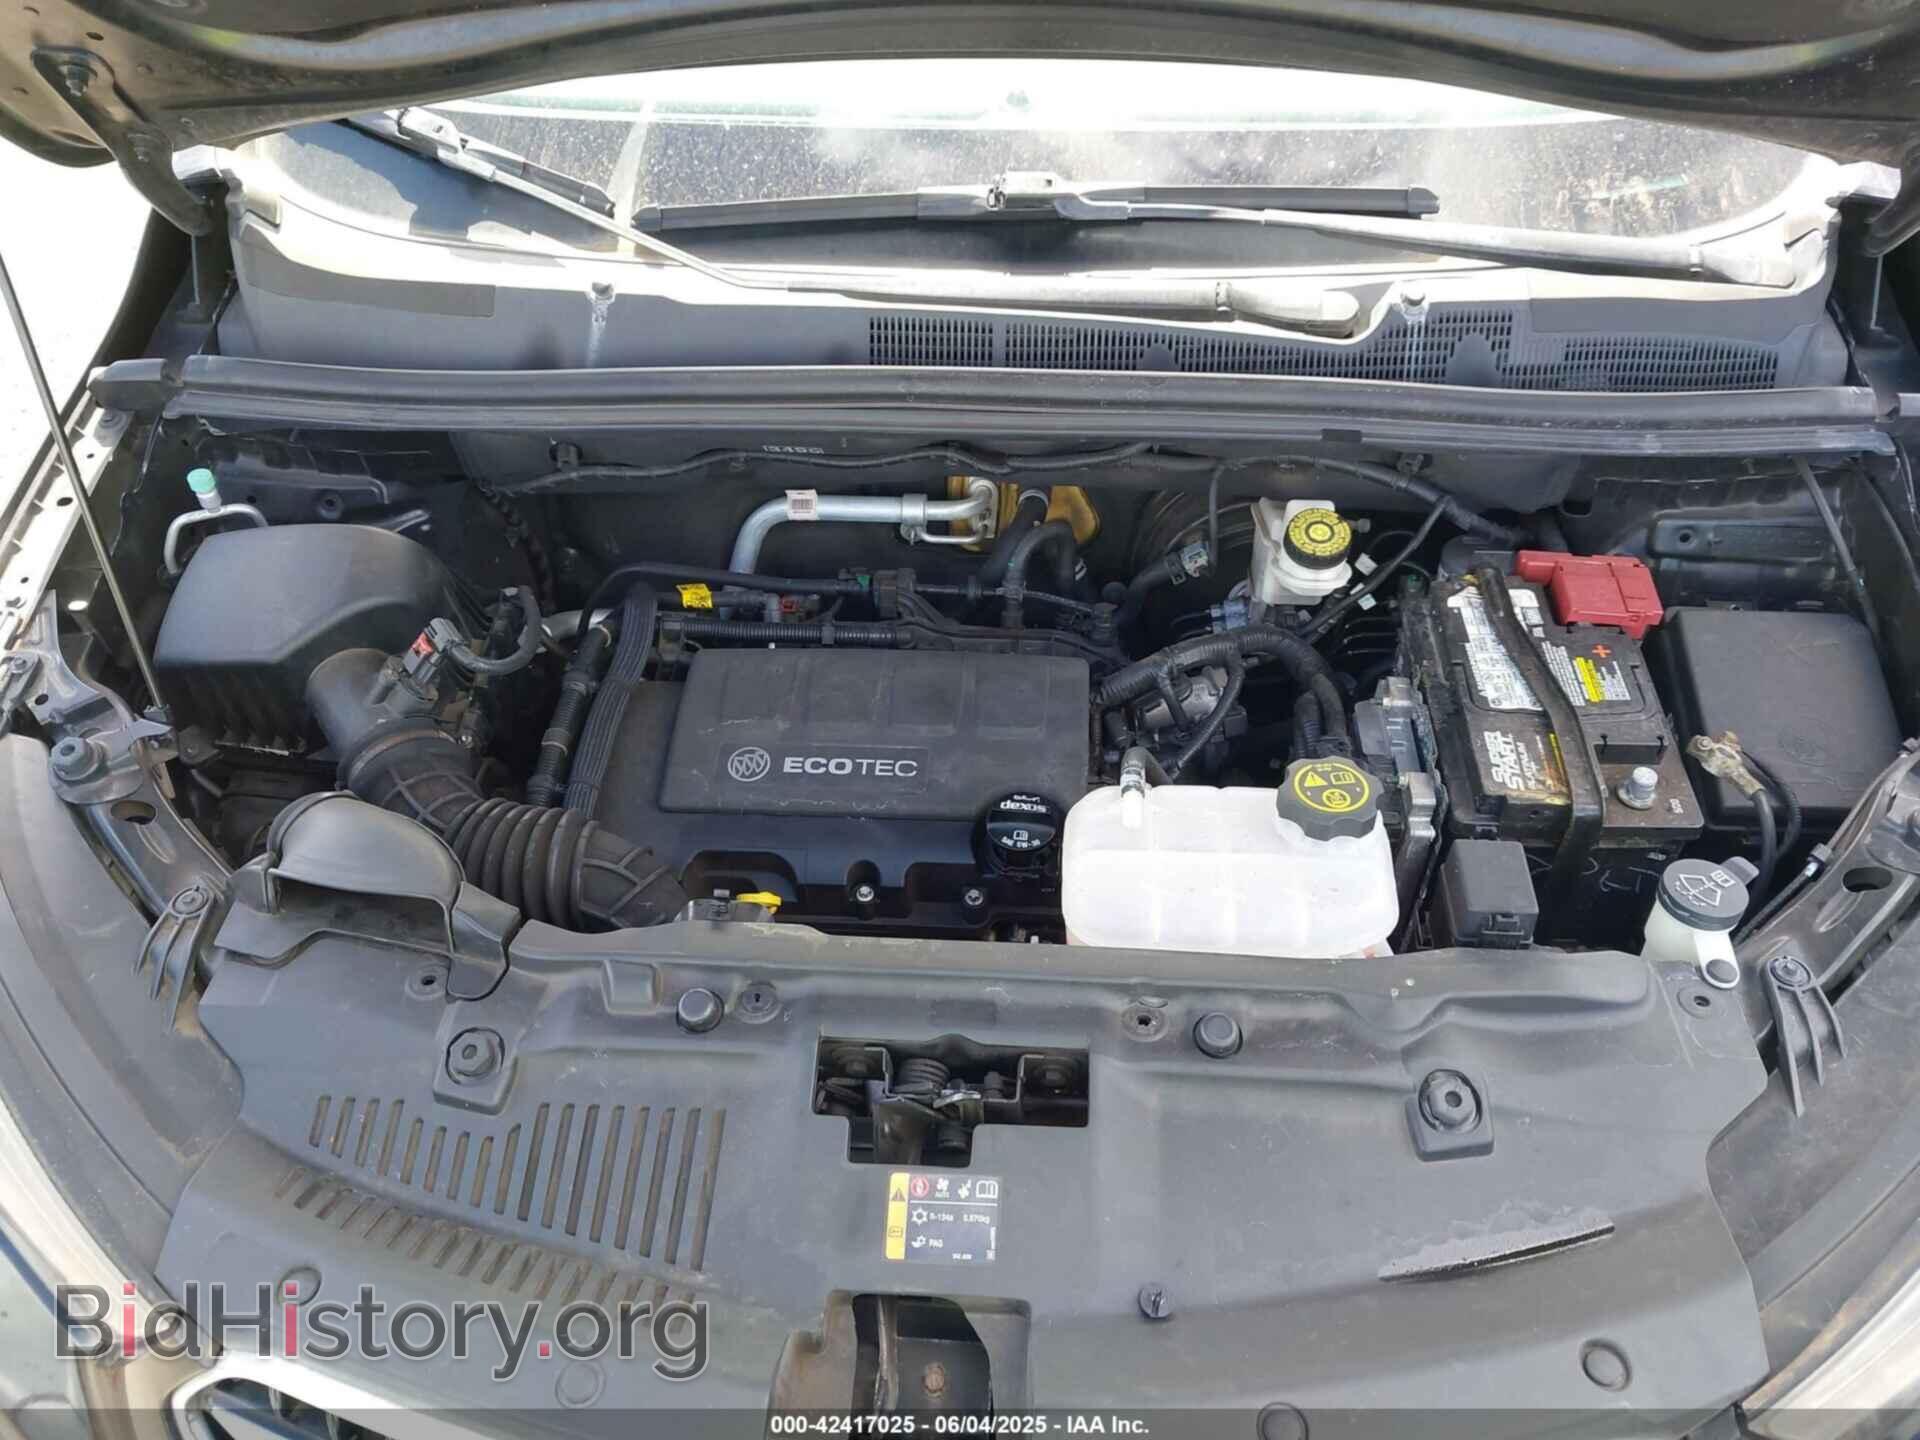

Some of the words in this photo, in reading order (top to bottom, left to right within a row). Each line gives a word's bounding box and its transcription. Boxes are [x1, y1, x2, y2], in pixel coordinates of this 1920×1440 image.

[783, 757, 918, 777] ECOTEC
[1483, 730, 1505, 783] SUPER
[1500, 733, 1526, 791] START
[1000, 799, 1047, 813] dexos
